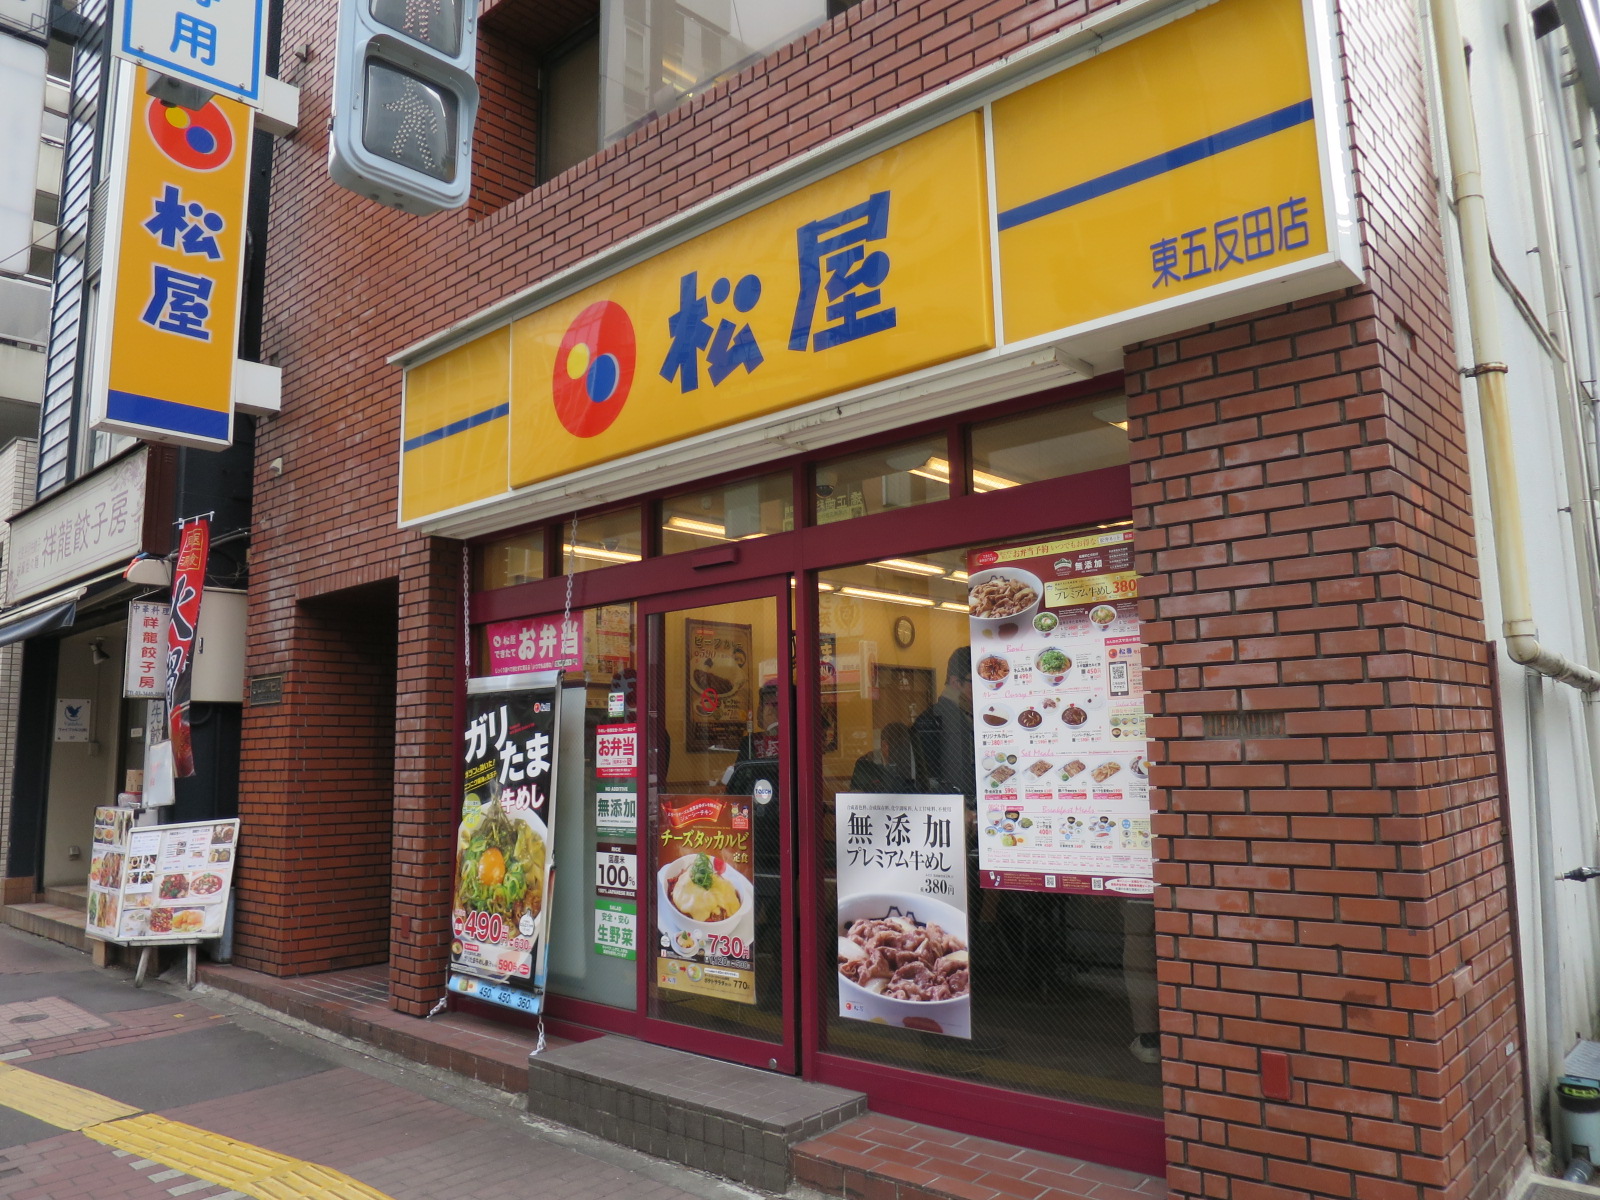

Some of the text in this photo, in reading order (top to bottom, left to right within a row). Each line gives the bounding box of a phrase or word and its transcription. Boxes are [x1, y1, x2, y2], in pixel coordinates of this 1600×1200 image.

[1150, 196, 1309, 288] 東五反田店
[142, 184, 224, 342] 松屋
[659, 190, 897, 394] 松屋
[1075, 559, 1102, 571] 無添加
[1055, 585, 1112, 600] プレミアム牛めし
[1112, 579, 1137, 593] 380
[133, 604, 170, 616] 中華料理
[518, 620, 579, 660] お弁当
[139, 616, 158, 688] 祥龍餃子房
[494, 648, 516, 658] できたて
[464, 705, 508, 763] ガリ
[598, 737, 635, 756] お弁当
[499, 732, 551, 785] たま
[501, 784, 544, 814] 牛めし
[598, 798, 636, 818] 無添加
[661, 829, 749, 850] チーズタッカルビ
[847, 811, 951, 848] 無添加
[608, 855, 625, 864] 国産米
[733, 852, 748, 863] 定食
[847, 846, 952, 872] プレミアム牛めし
[598, 864, 635, 887] 100%
[925, 879, 955, 895] 380円
[602, 913, 630, 924] 安全・安心
[598, 924, 633, 946] 生野菜
